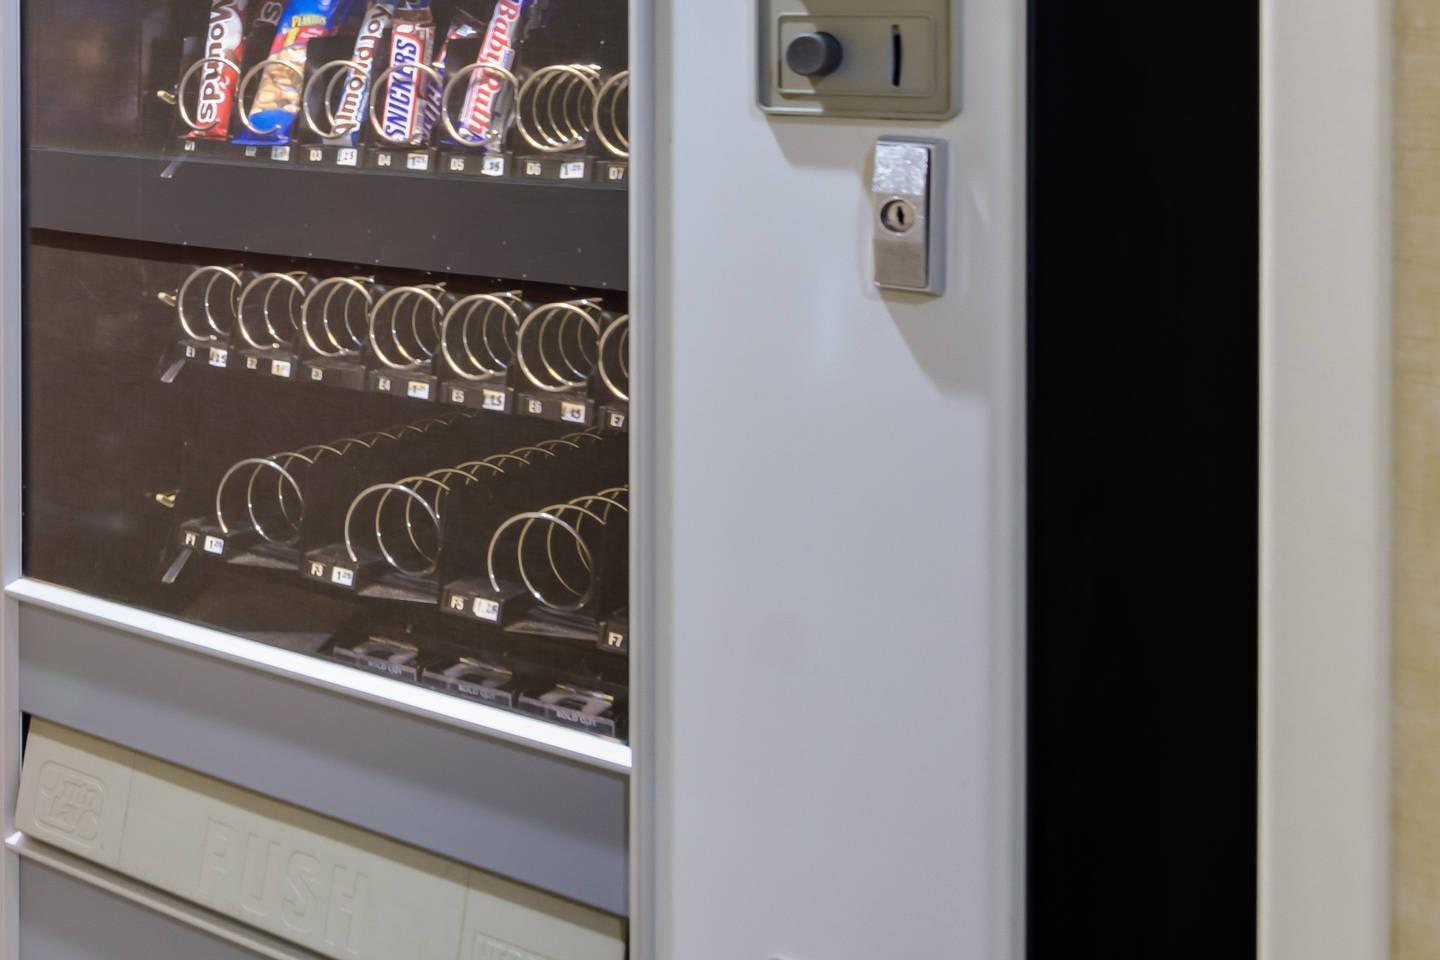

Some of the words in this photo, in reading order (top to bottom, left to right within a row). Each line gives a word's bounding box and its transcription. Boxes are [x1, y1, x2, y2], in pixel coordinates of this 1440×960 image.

[385, 38, 417, 140] SNICKERS
[469, 69, 502, 135] Ruth
[451, 389, 464, 403] E5
[529, 400, 542, 414] E6
[611, 413, 624, 427] E7
[450, 595, 464, 610] F5
[608, 632, 624, 647] F7
[200, 816, 369, 956] PUSH
